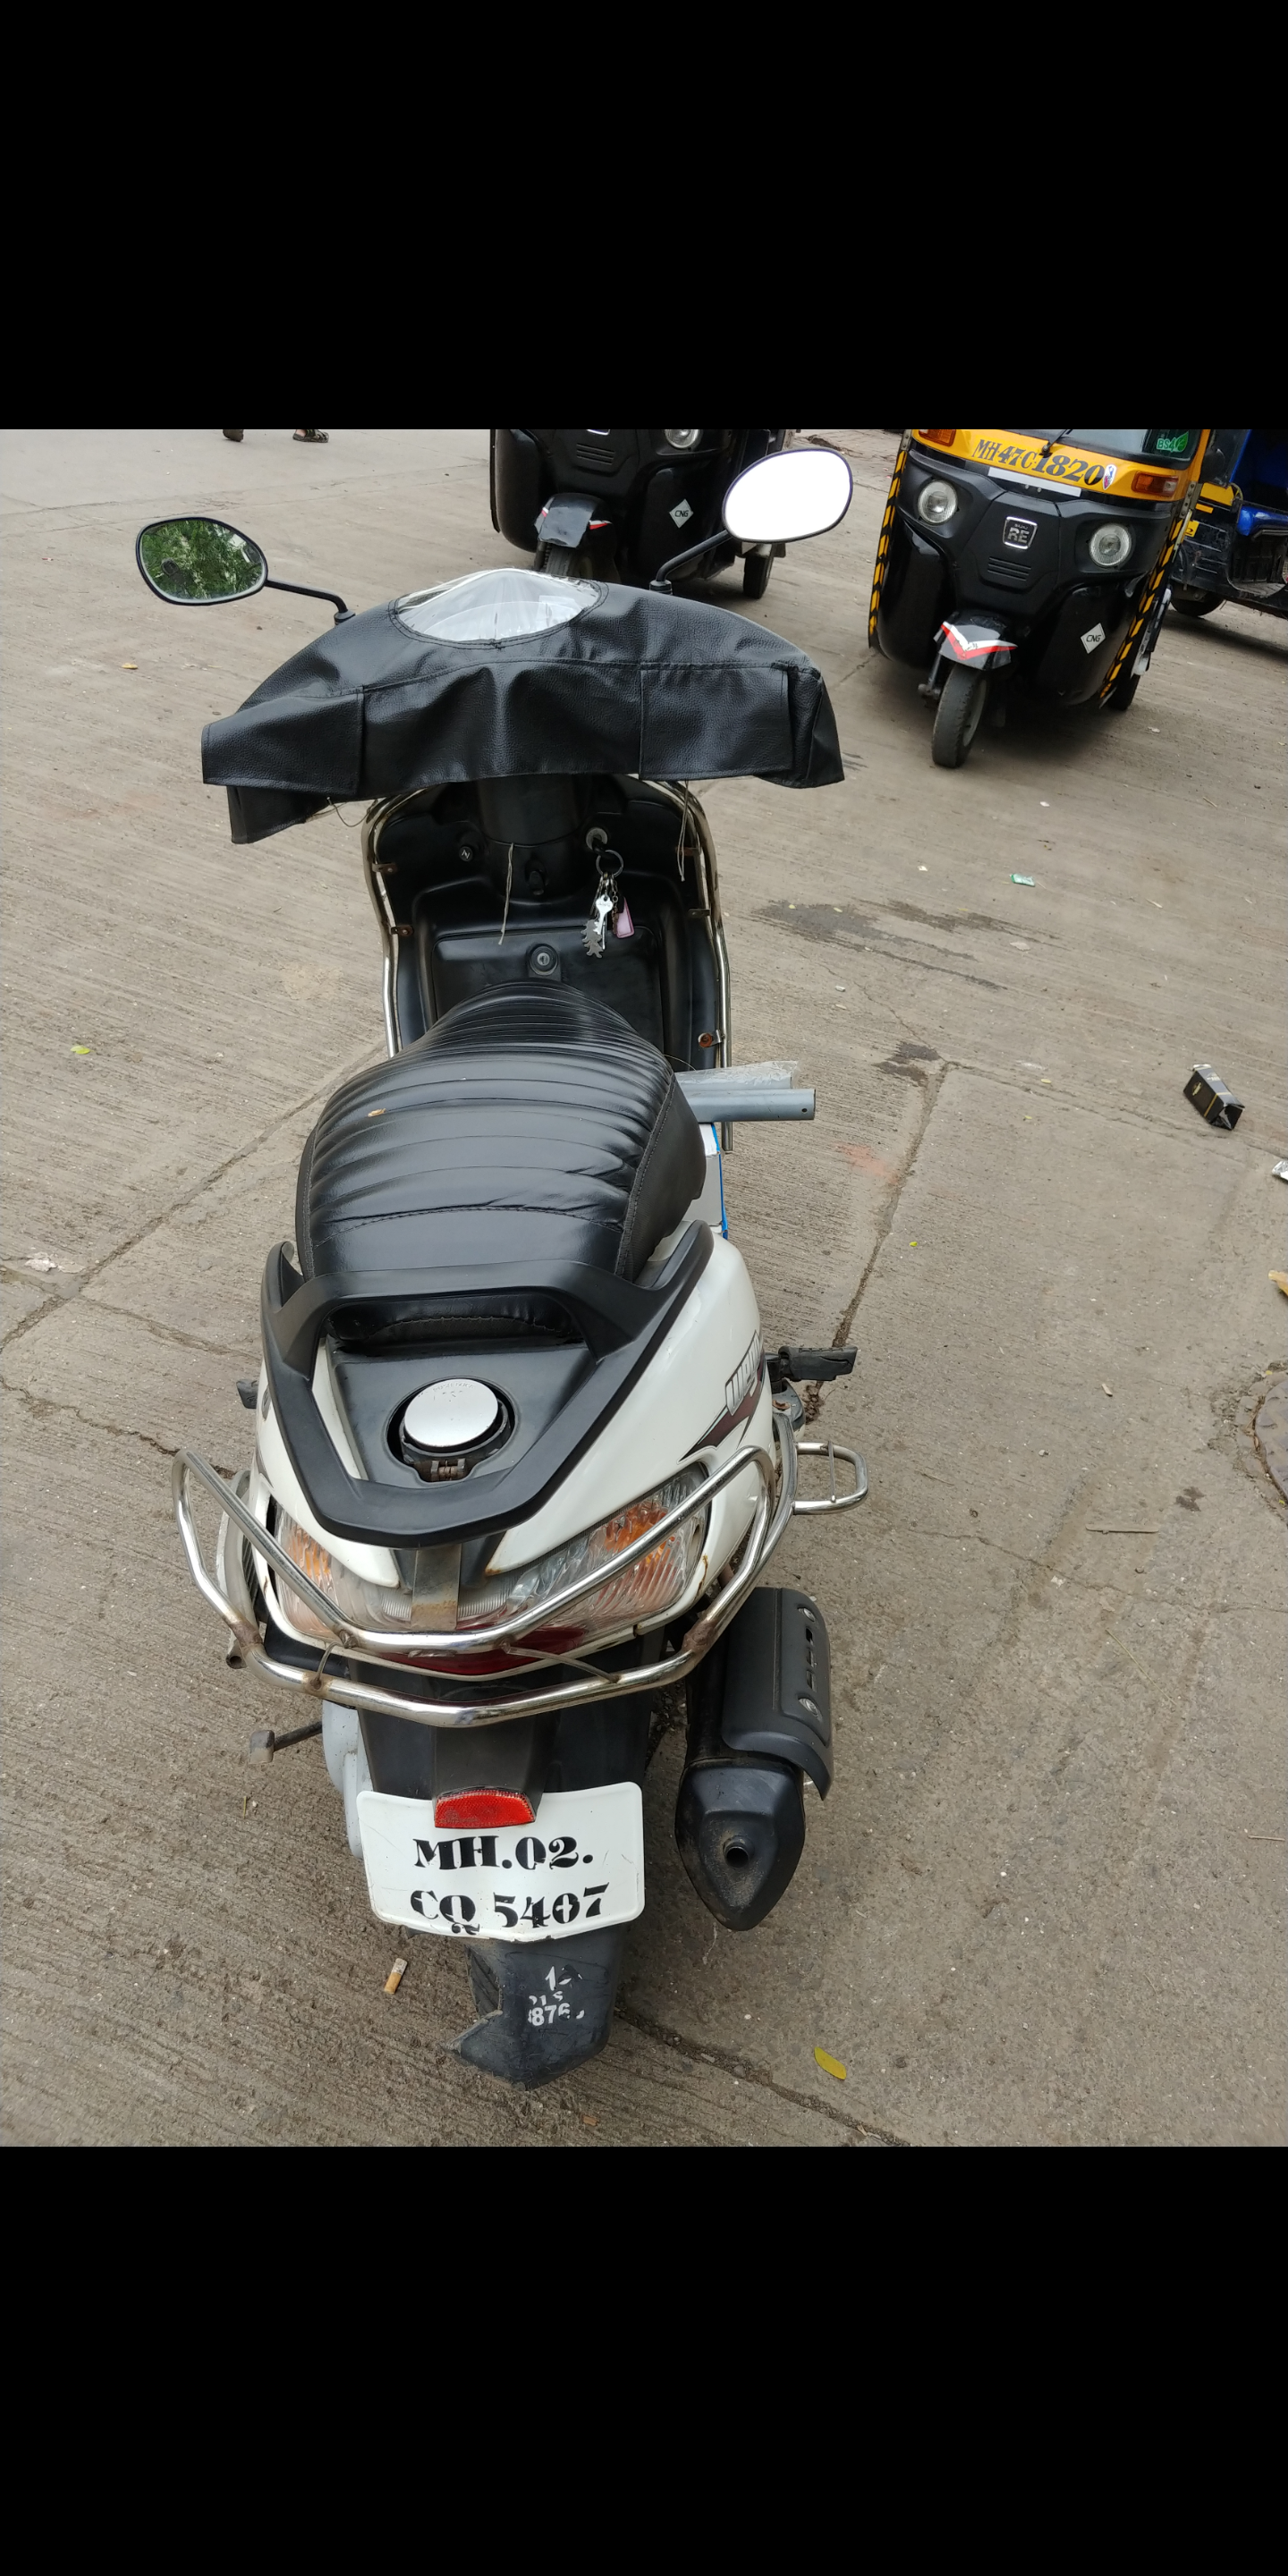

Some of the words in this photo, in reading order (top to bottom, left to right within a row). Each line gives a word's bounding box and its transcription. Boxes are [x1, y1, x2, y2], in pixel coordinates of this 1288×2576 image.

[1157, 437, 1176, 452] BS4
[1007, 527, 1030, 544] RE
[1086, 634, 1102, 642] CNG
[410, 1889, 480, 1936] CQ
[492, 1881, 610, 1929] 5407
